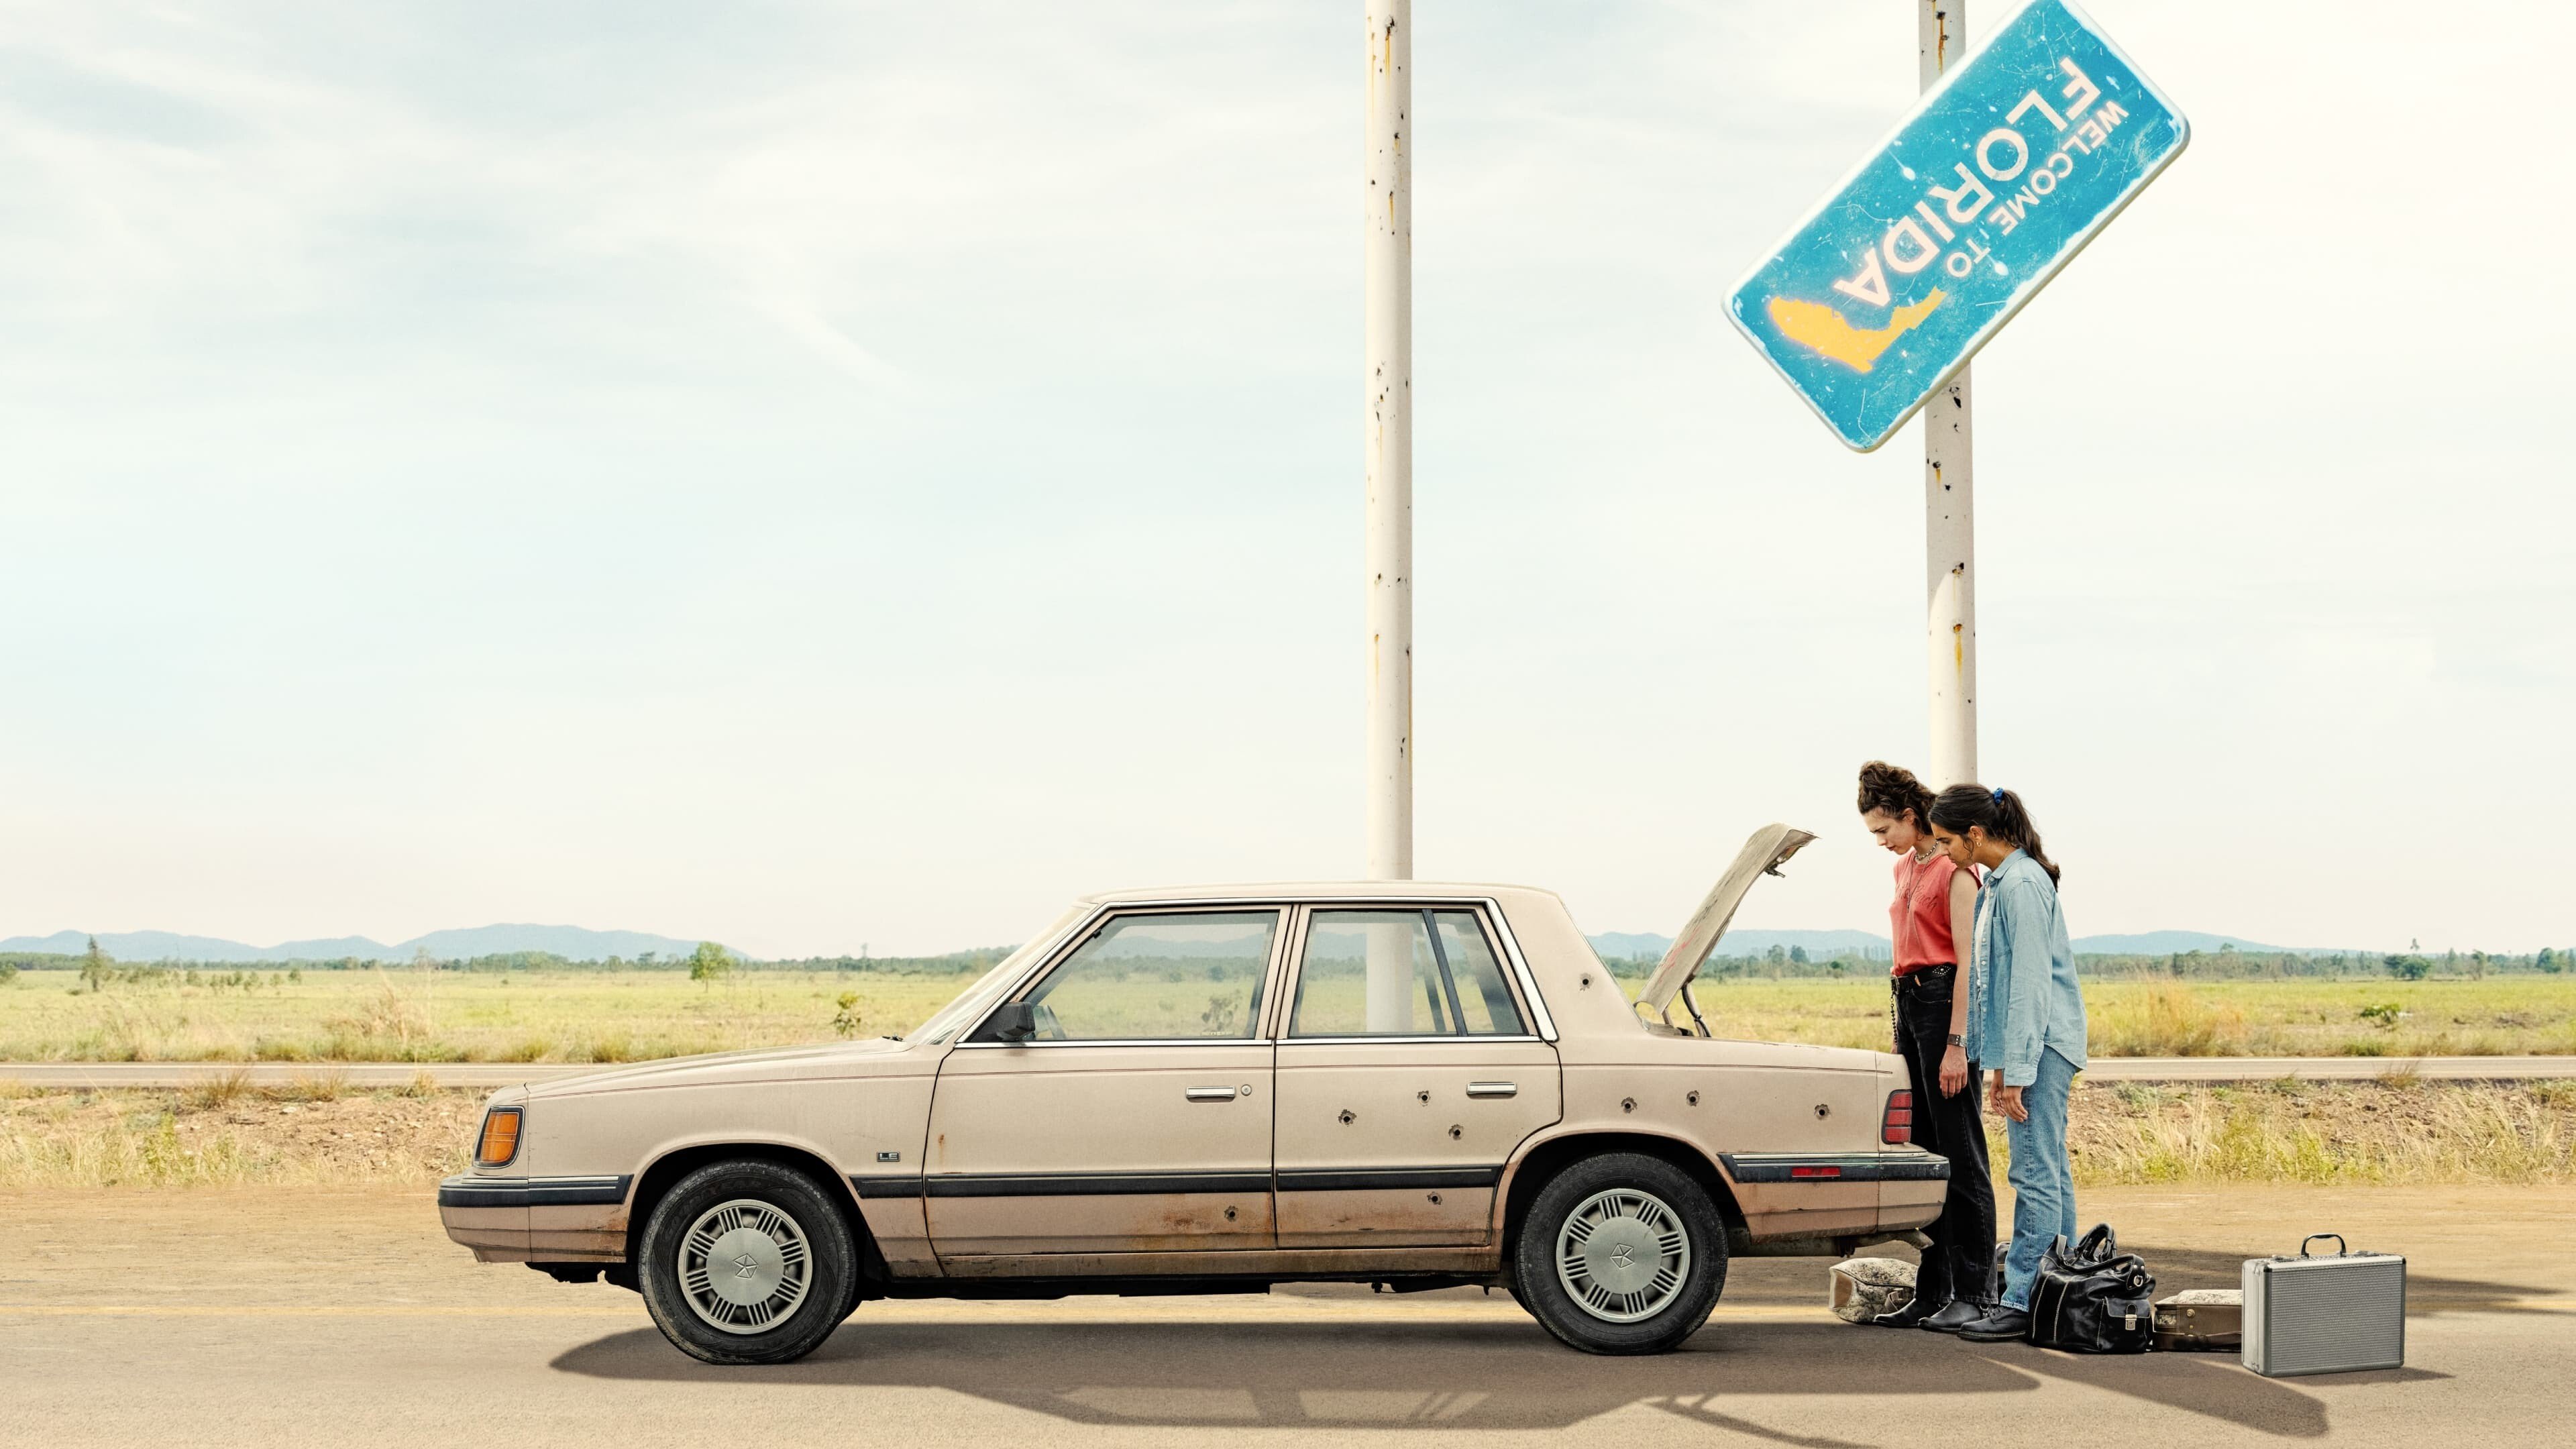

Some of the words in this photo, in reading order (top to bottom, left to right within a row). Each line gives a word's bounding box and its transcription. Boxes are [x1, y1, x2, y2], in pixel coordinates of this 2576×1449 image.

[1833, 57, 2101, 307] FLORIDA
[1988, 101, 2129, 235] WELCOME
[1946, 238, 1990, 278] TO
